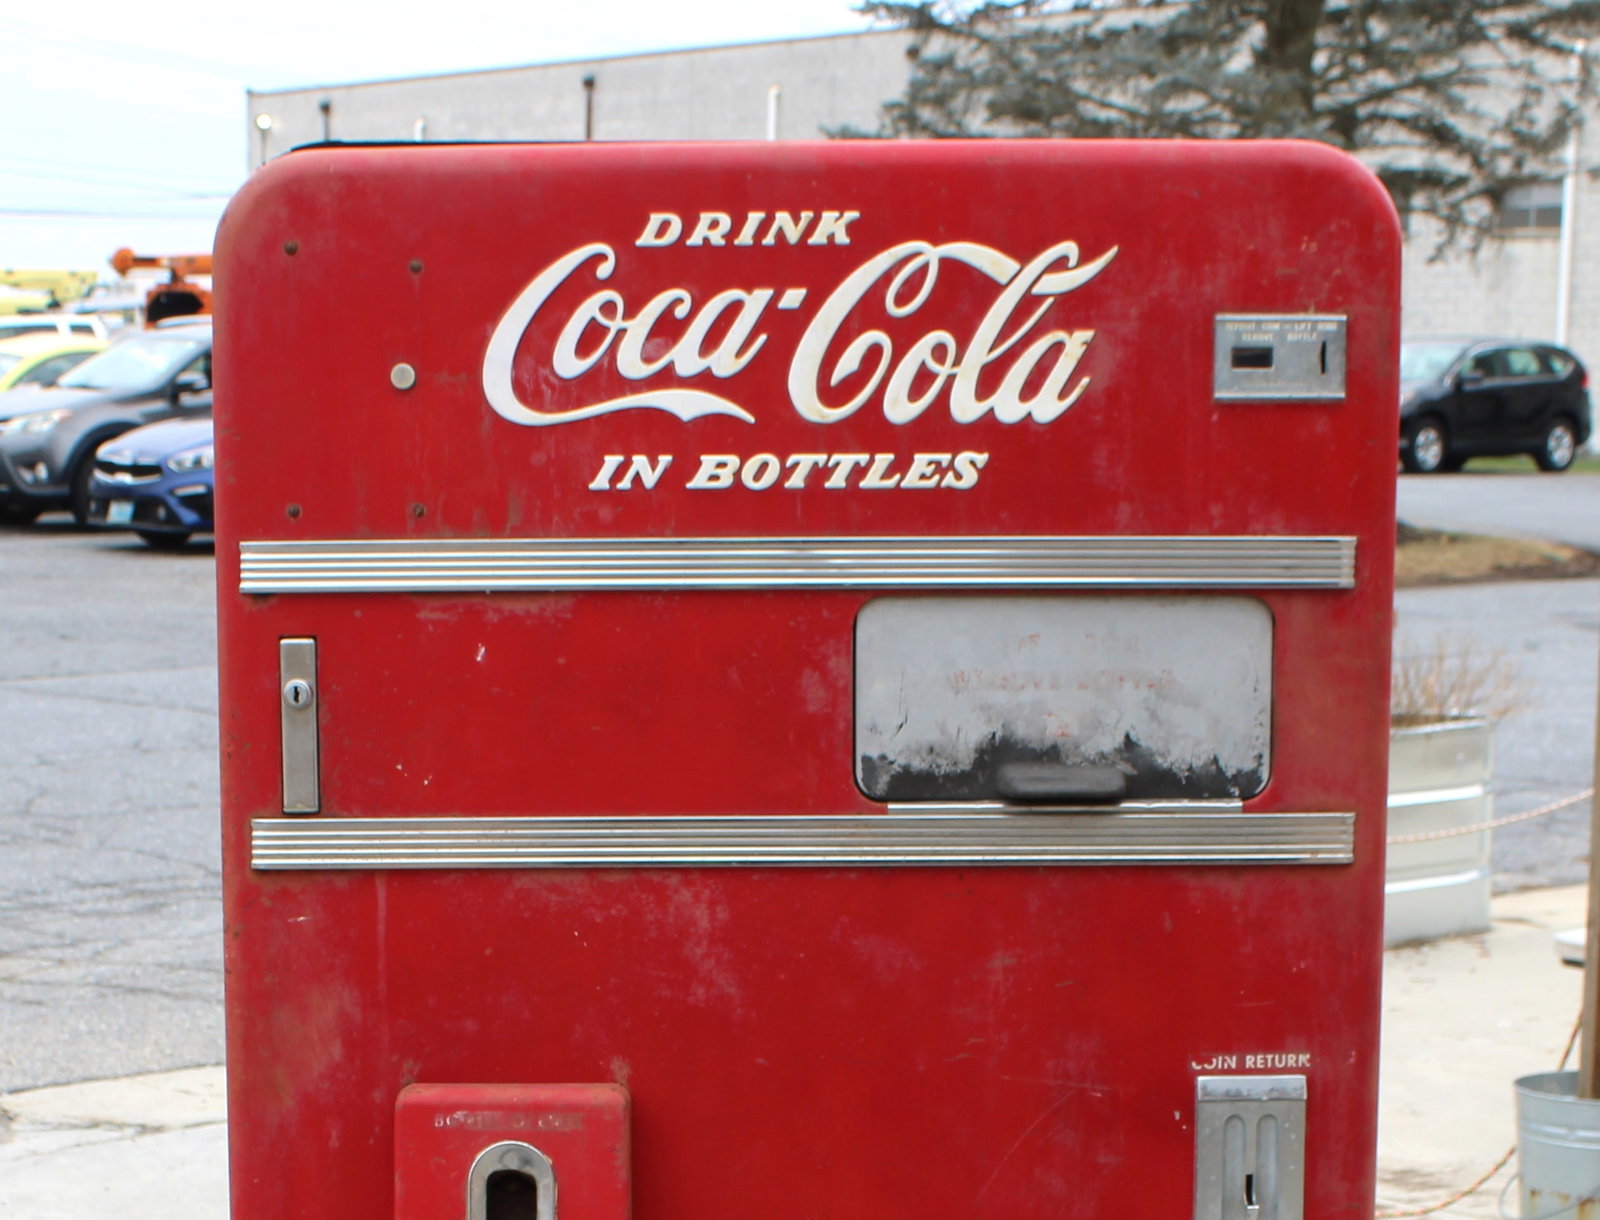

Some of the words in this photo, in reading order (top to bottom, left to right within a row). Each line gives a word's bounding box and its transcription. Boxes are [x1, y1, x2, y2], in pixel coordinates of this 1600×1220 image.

[635, 210, 861, 248] DRINK
[481, 240, 1119, 427] Coca-Cola
[588, 453, 674, 491] IN
[685, 451, 990, 491] BOTTLES
